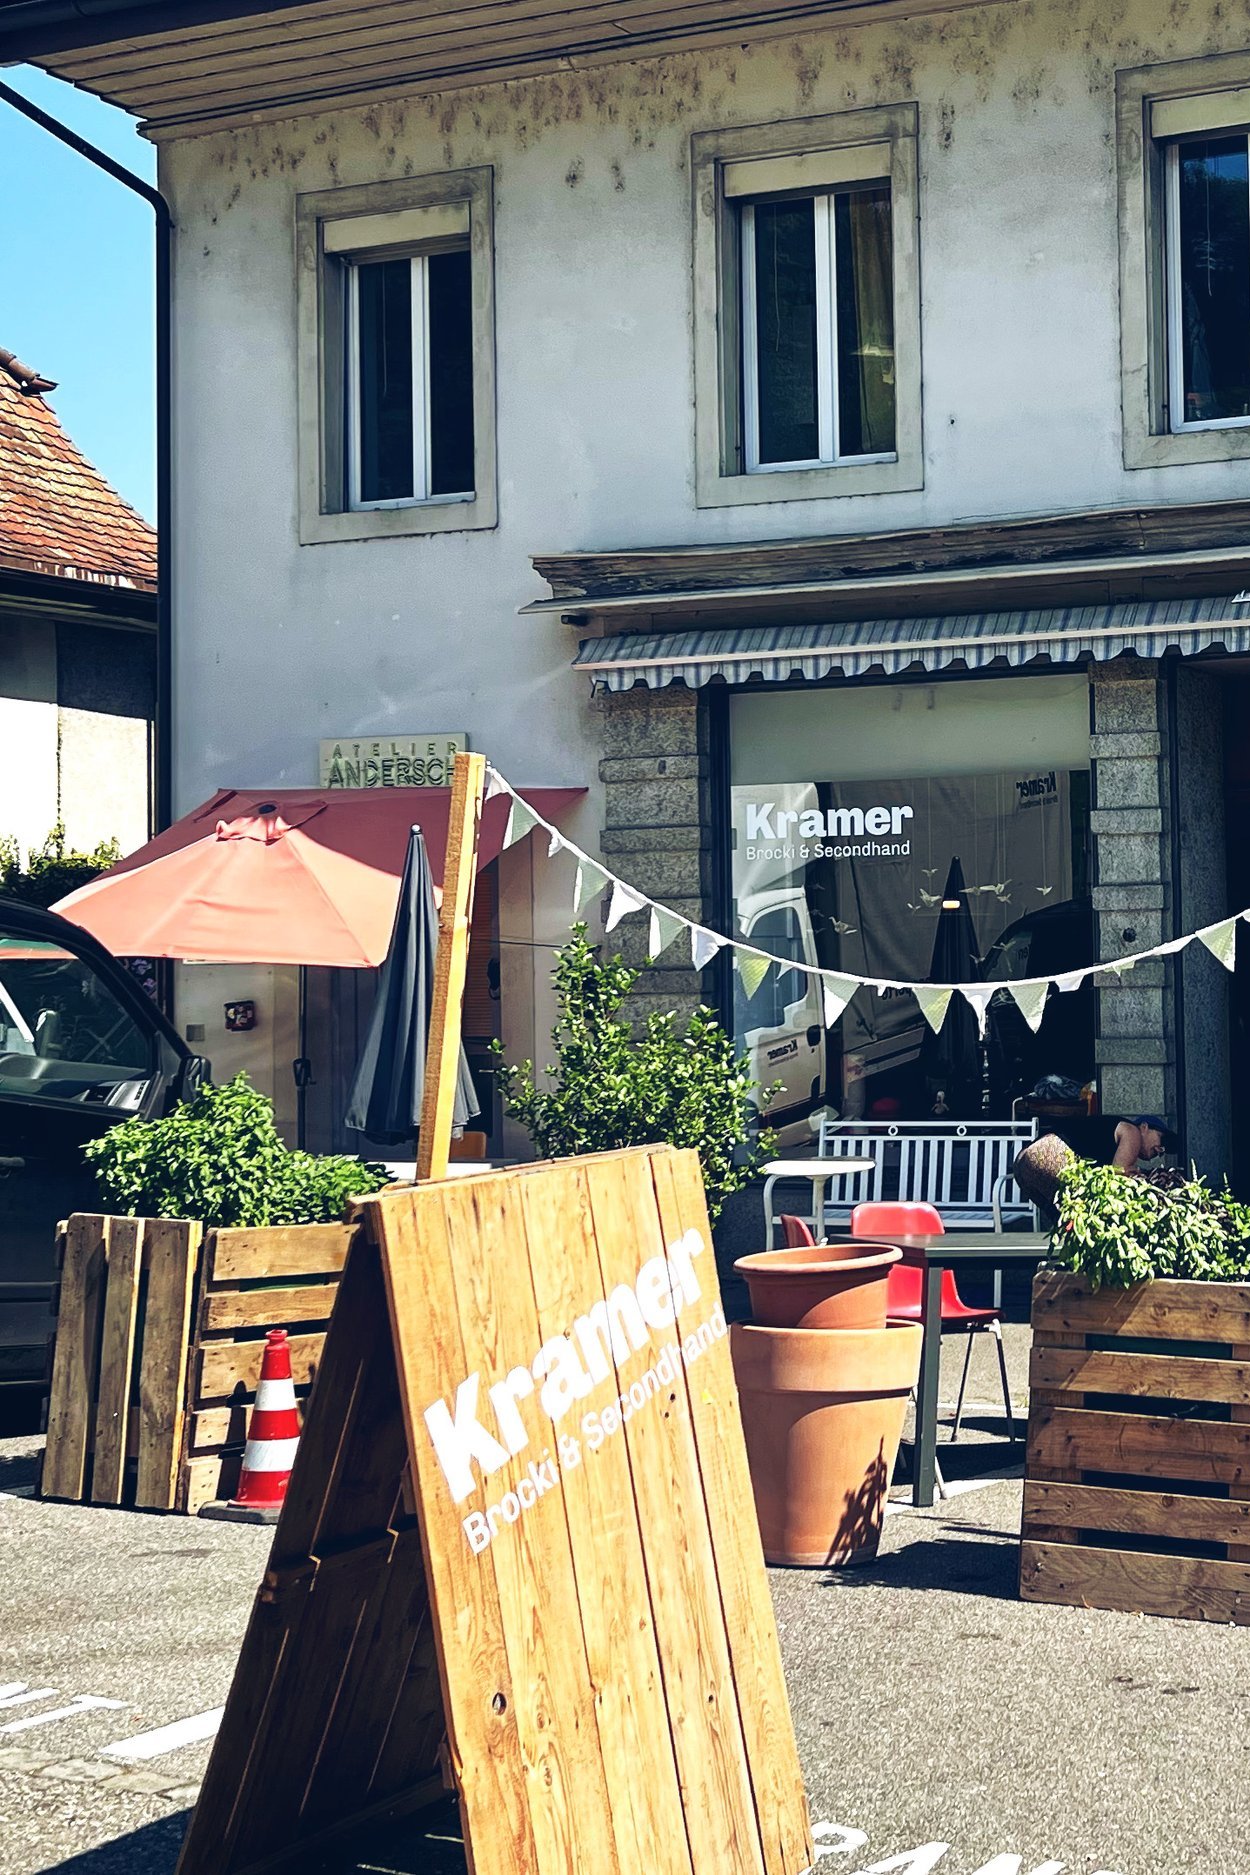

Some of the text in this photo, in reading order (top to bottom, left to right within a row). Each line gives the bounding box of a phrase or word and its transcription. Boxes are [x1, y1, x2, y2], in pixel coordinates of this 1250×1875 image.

[333, 741, 458, 759] ATELIER
[745, 803, 914, 840] Kramer
[746, 840, 911, 860] Brocki & Secondhand
[423, 1228, 705, 1504] Kramer
[461, 1303, 728, 1556] Brocki & Secondhand
